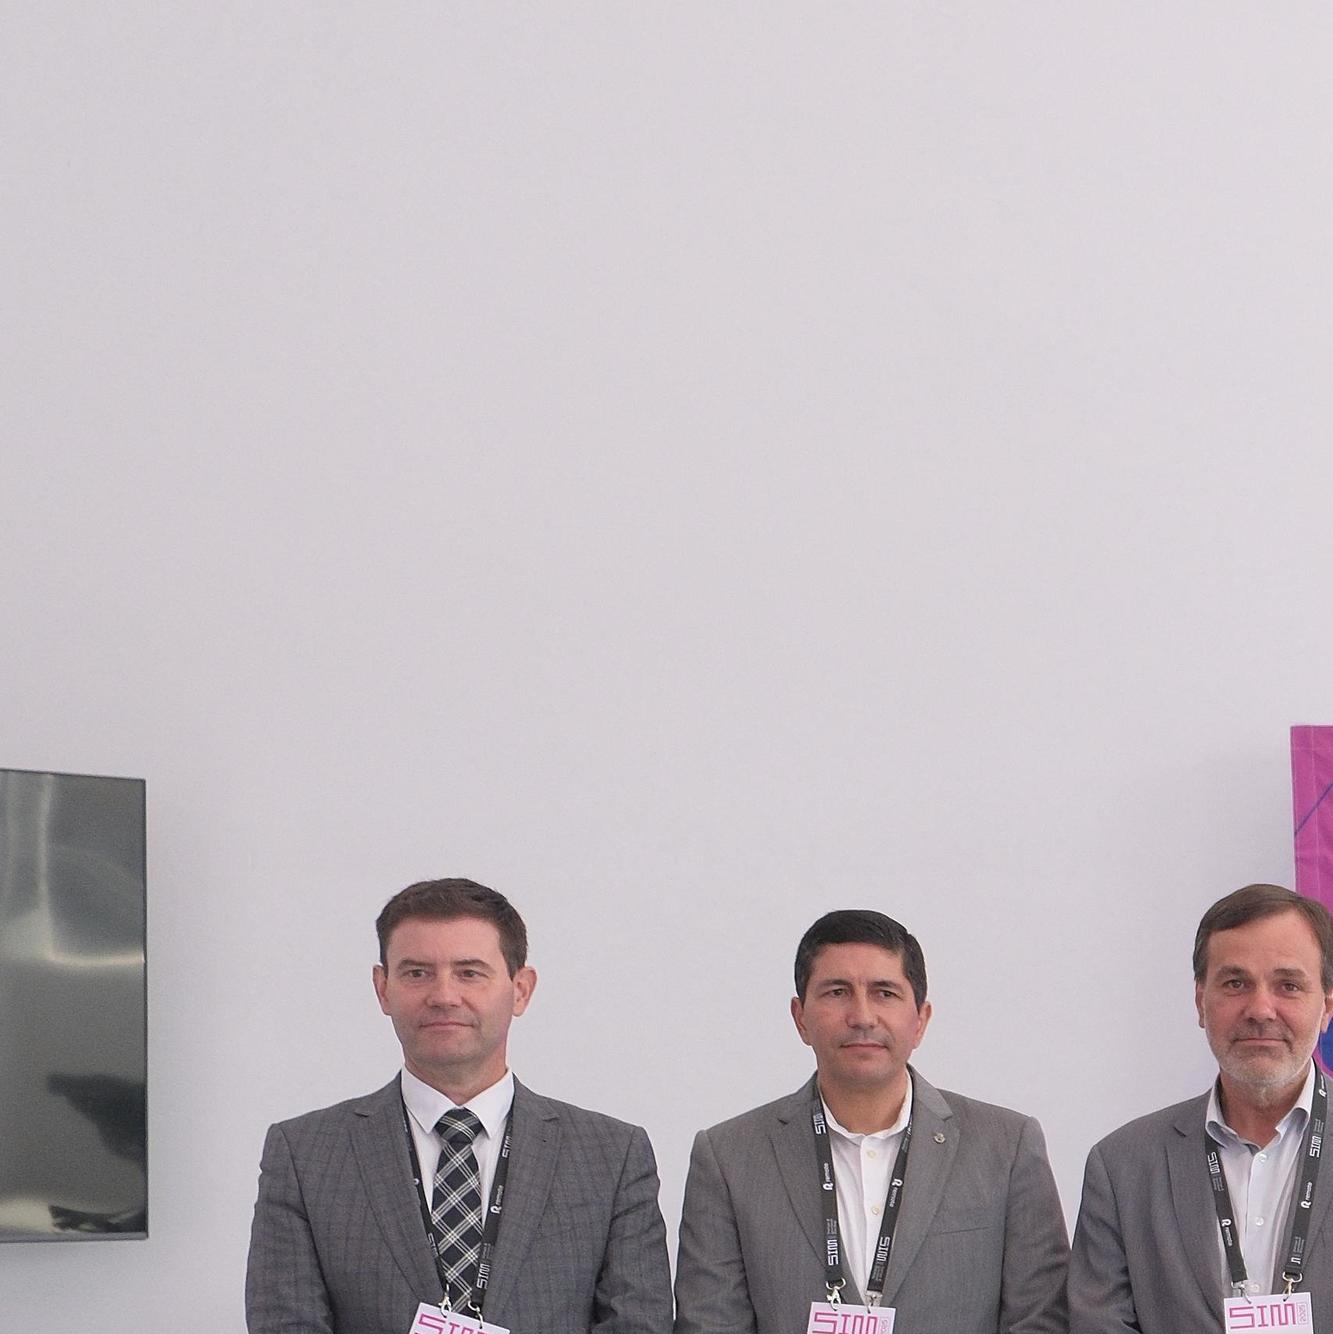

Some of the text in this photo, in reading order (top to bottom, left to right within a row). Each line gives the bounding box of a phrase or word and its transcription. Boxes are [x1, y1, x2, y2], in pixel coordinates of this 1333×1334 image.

[1309, 1135, 1322, 1158] SIM
[1207, 1151, 1220, 1174] SIM
[827, 1239, 839, 1266] SIM
[876, 1236, 890, 1261] SIM
[476, 1263, 491, 1289] SIM
[1229, 1303, 1296, 1329] SIM
